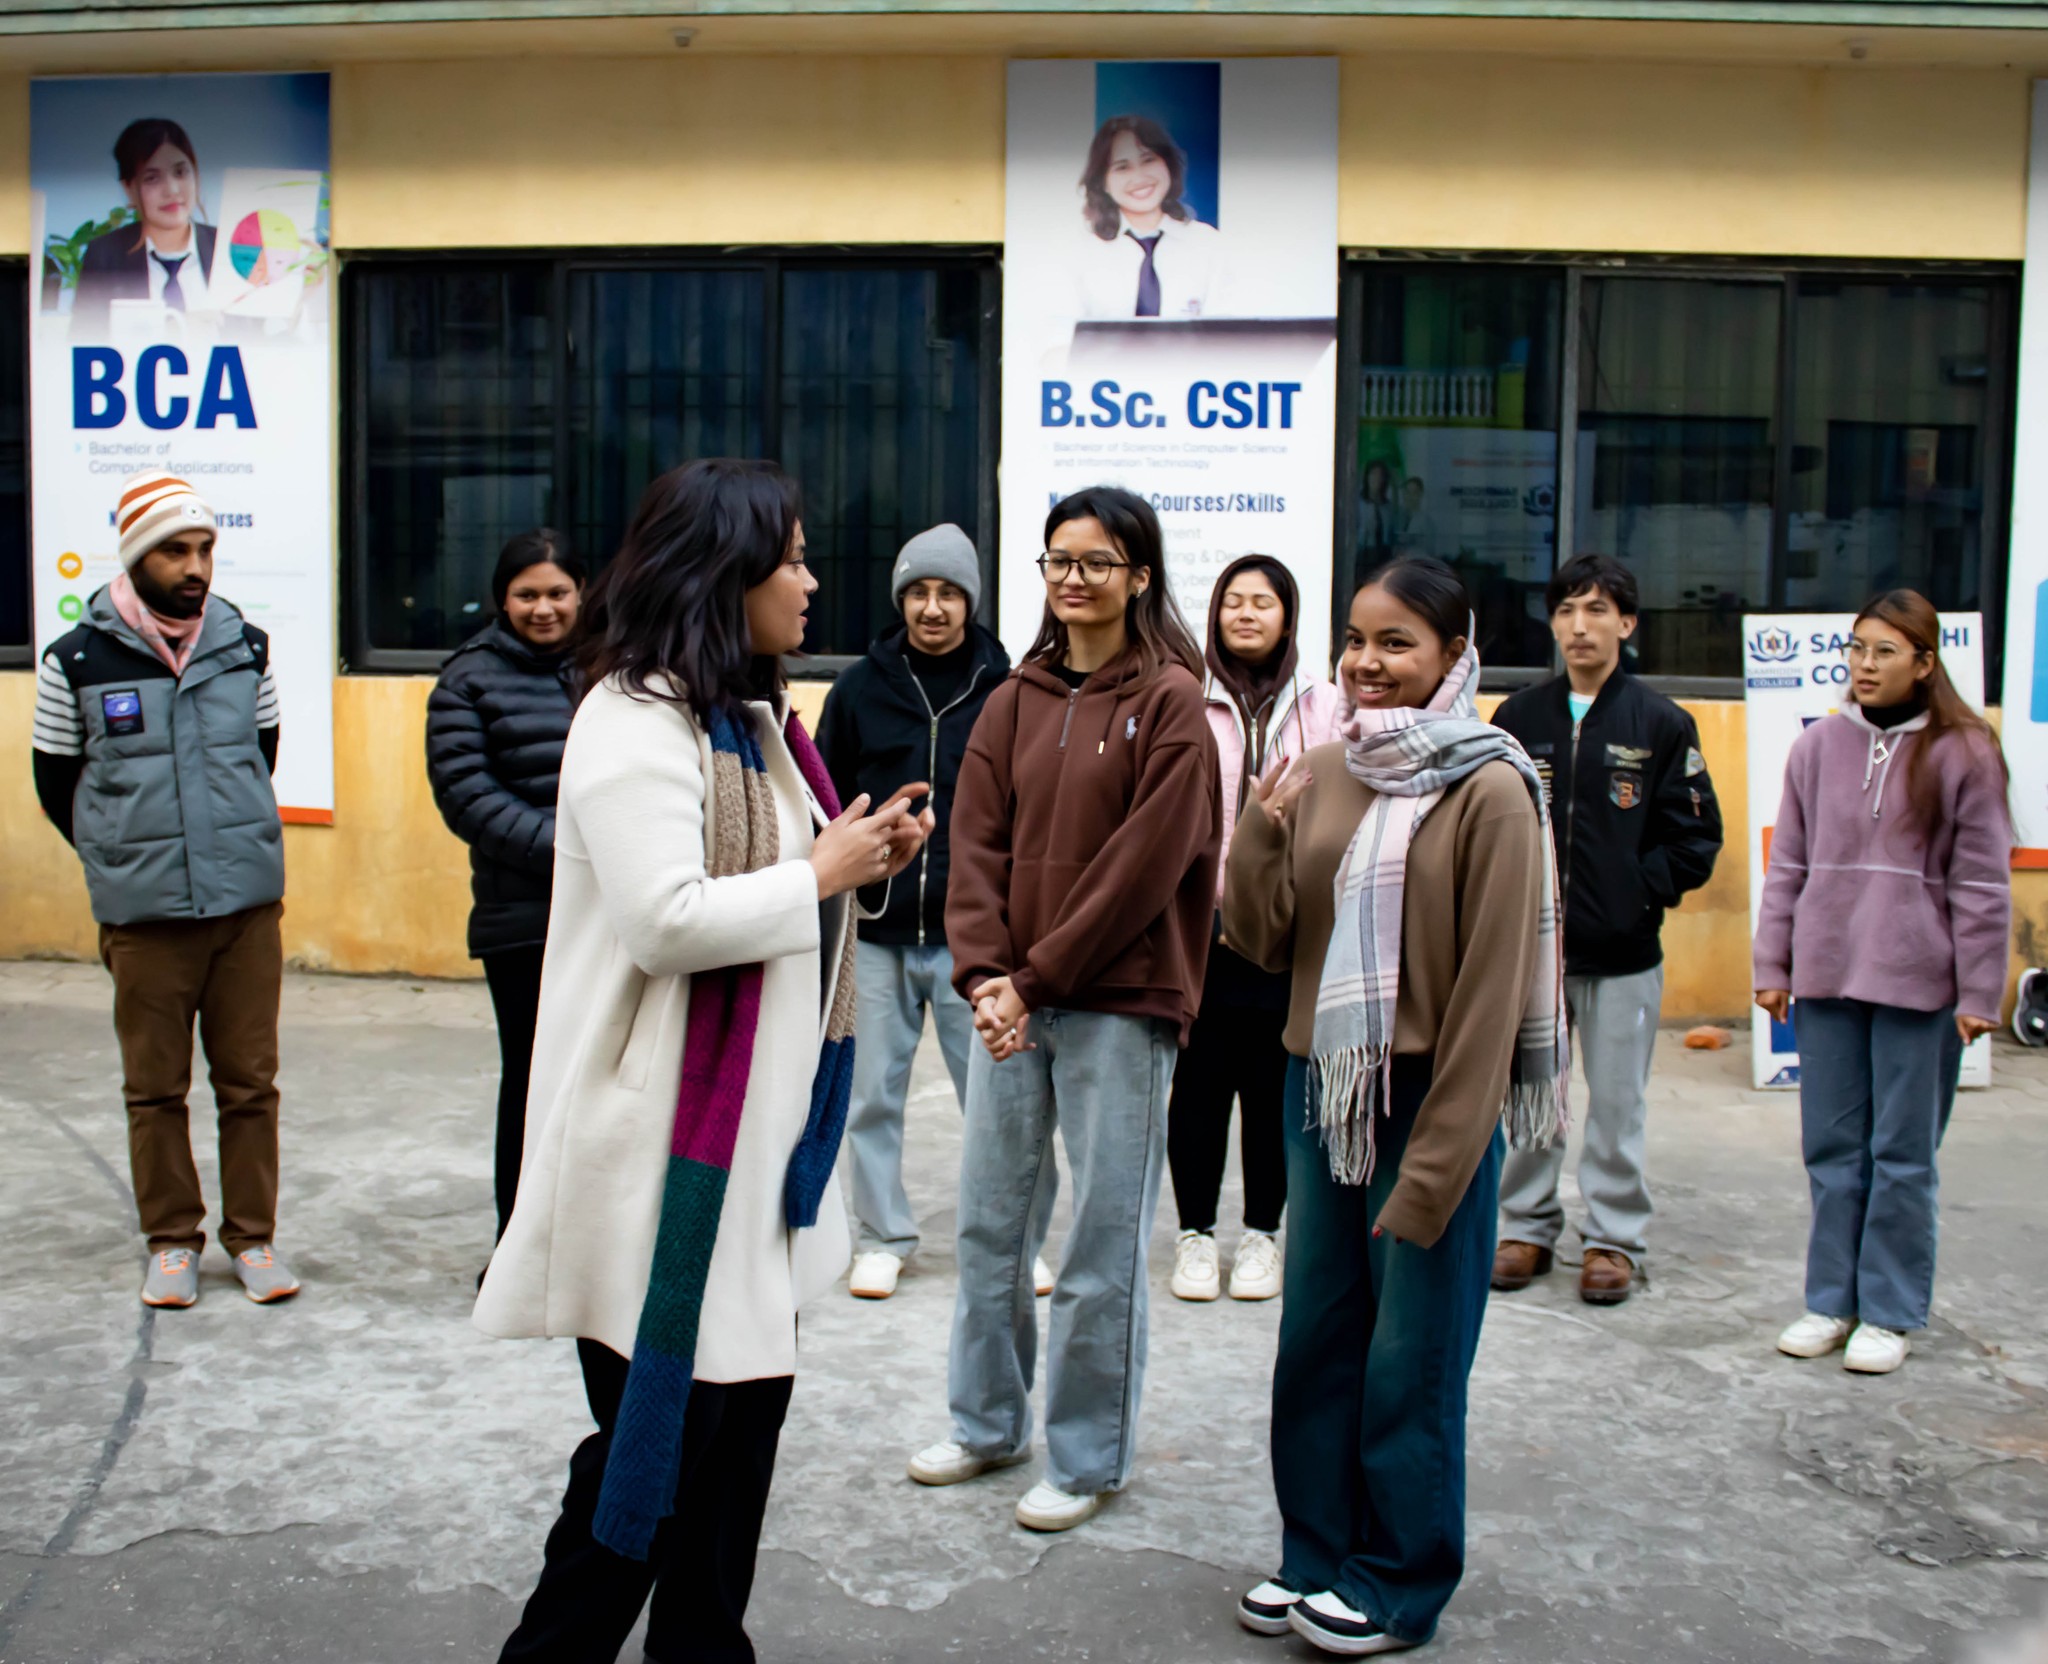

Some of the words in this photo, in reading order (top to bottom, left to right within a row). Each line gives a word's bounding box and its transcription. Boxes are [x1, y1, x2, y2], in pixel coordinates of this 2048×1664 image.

[73, 345, 258, 430] BCA
[1041, 380, 1166, 428] B.Sc.
[1187, 381, 1302, 429] CSIT
[88, 441, 151, 455] Bachelor
[156, 441, 171, 455] of
[165, 460, 254, 474] Applications
[1151, 493, 1286, 513] Courses/Skills
